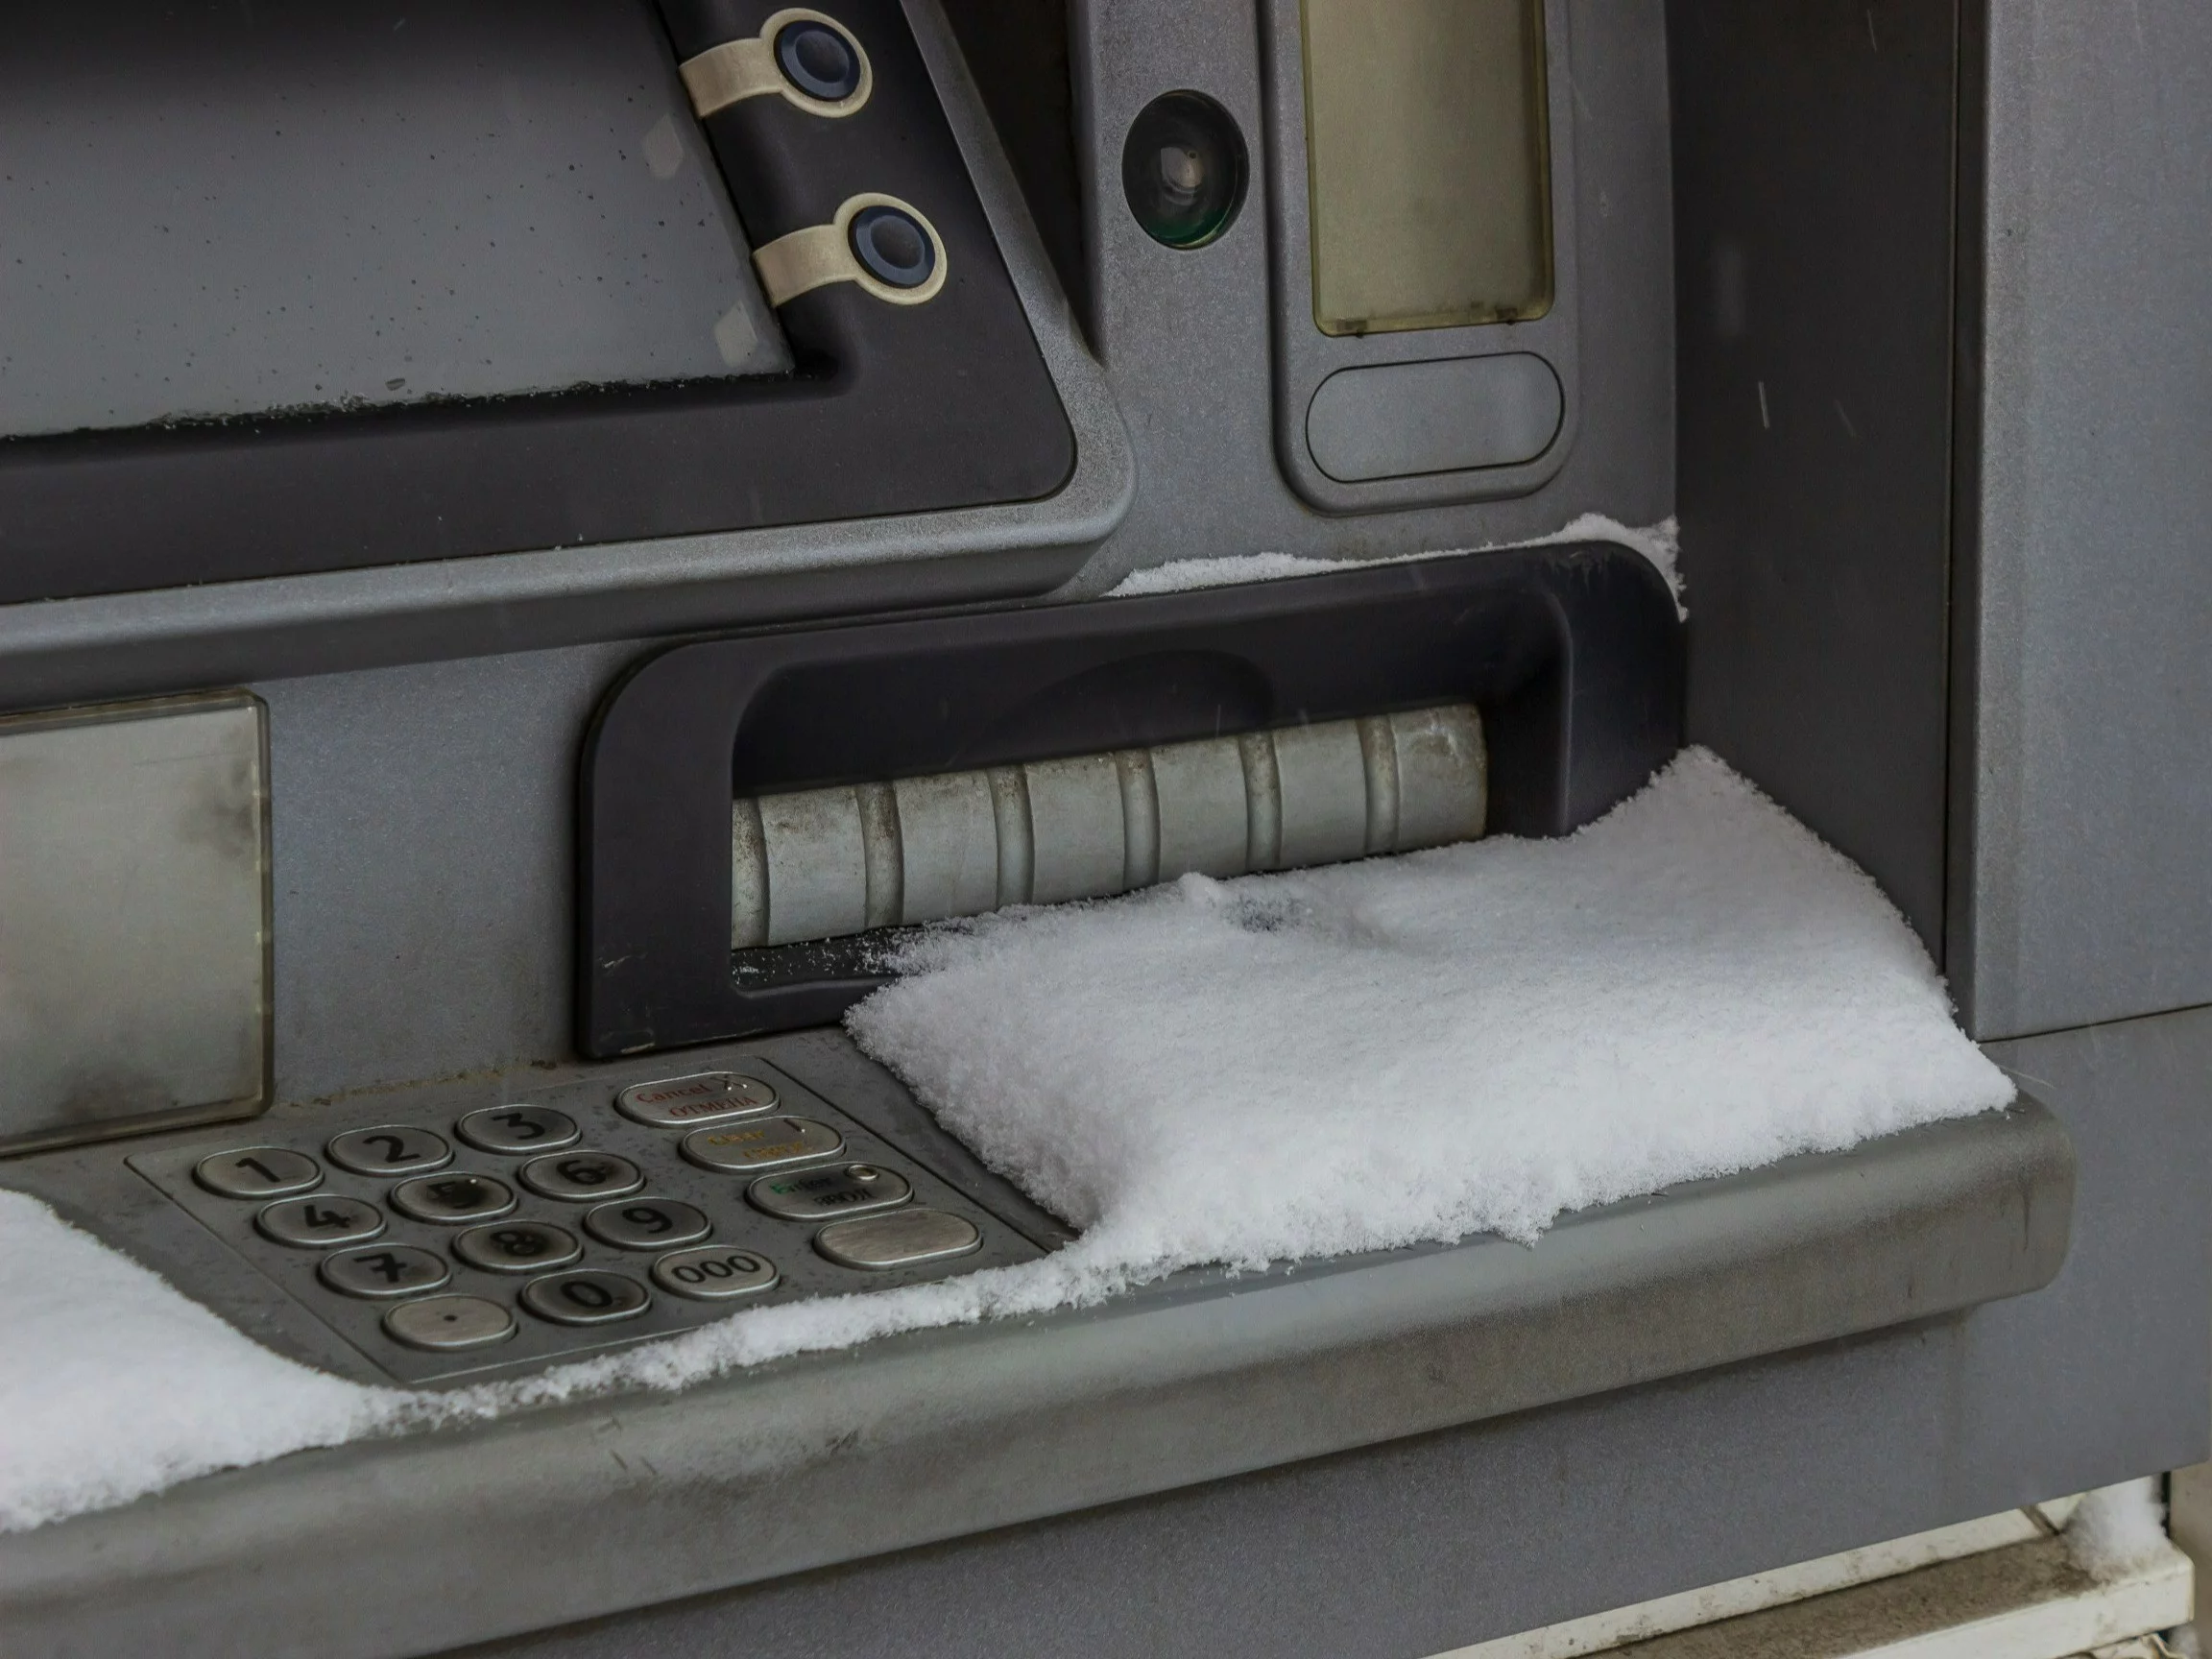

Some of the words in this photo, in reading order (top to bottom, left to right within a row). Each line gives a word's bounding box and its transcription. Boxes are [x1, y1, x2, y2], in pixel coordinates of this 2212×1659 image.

[636, 1083, 712, 1103] Cancel
[493, 1112, 545, 1140] 3
[362, 1134, 420, 1163] 2
[235, 1155, 281, 1183] 1
[556, 1158, 605, 1186] 6
[304, 1203, 349, 1230] 4
[622, 1206, 673, 1234] 9
[493, 1229, 538, 1257] 8
[353, 1252, 407, 1283] 7
[672, 1255, 761, 1284] 000
[561, 1280, 613, 1310] 0
